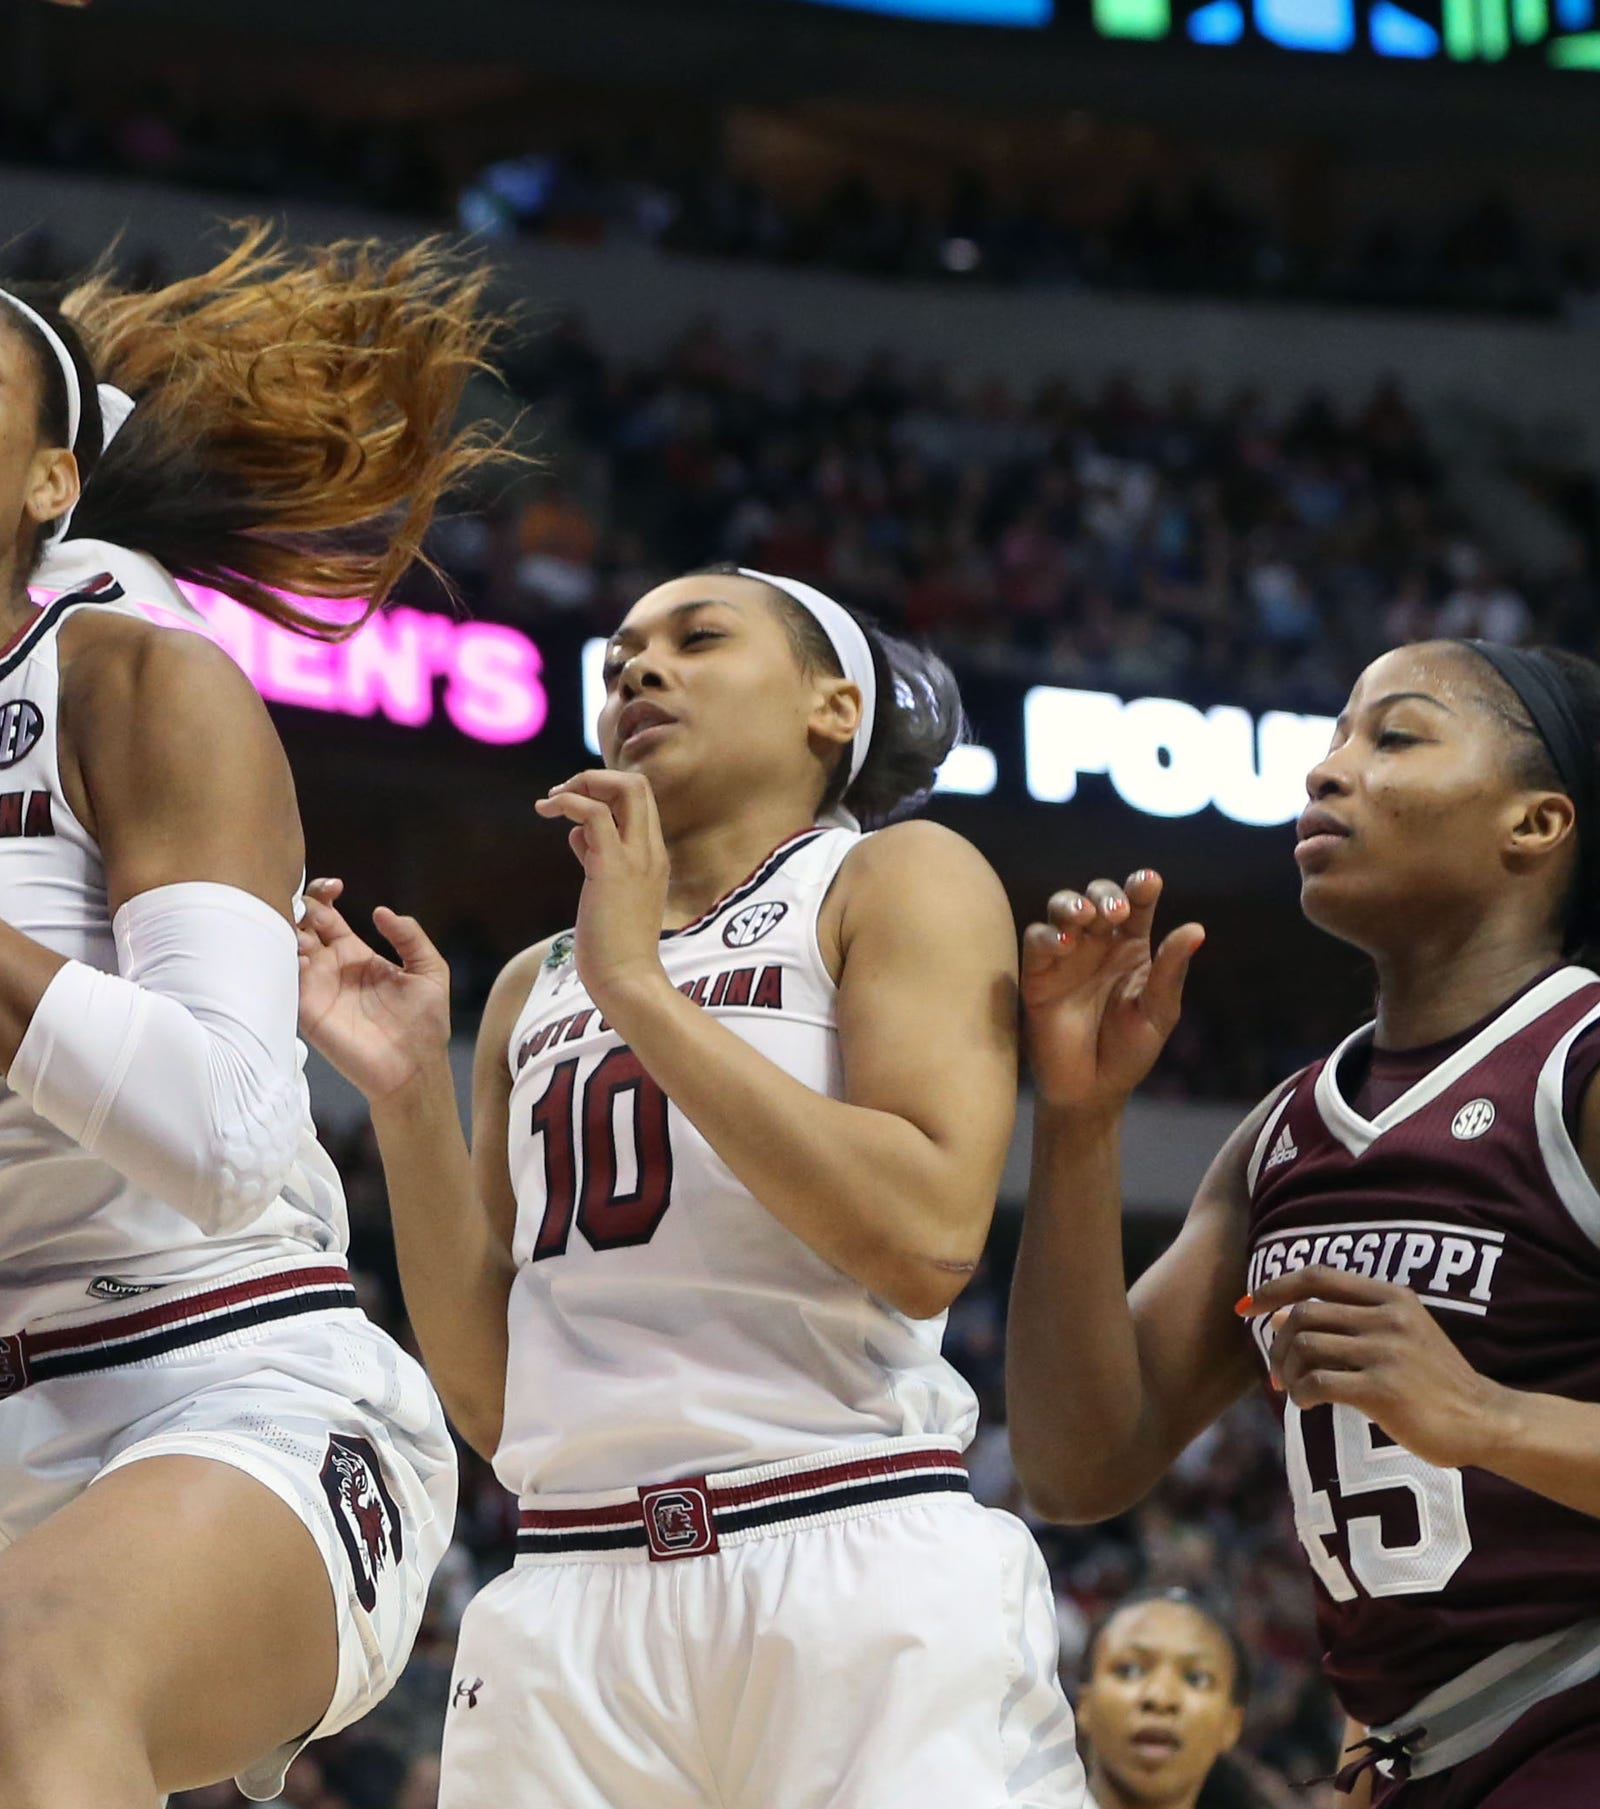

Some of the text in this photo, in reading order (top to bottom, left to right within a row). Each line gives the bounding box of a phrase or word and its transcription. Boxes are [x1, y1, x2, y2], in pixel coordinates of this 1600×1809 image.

[1024, 685, 1337, 826] FOU
[726, 902, 784, 947] SEC
[531, 1045, 673, 1262] 10
[1453, 1101, 1492, 1137] SEC
[1284, 1392, 1472, 1602] 45
